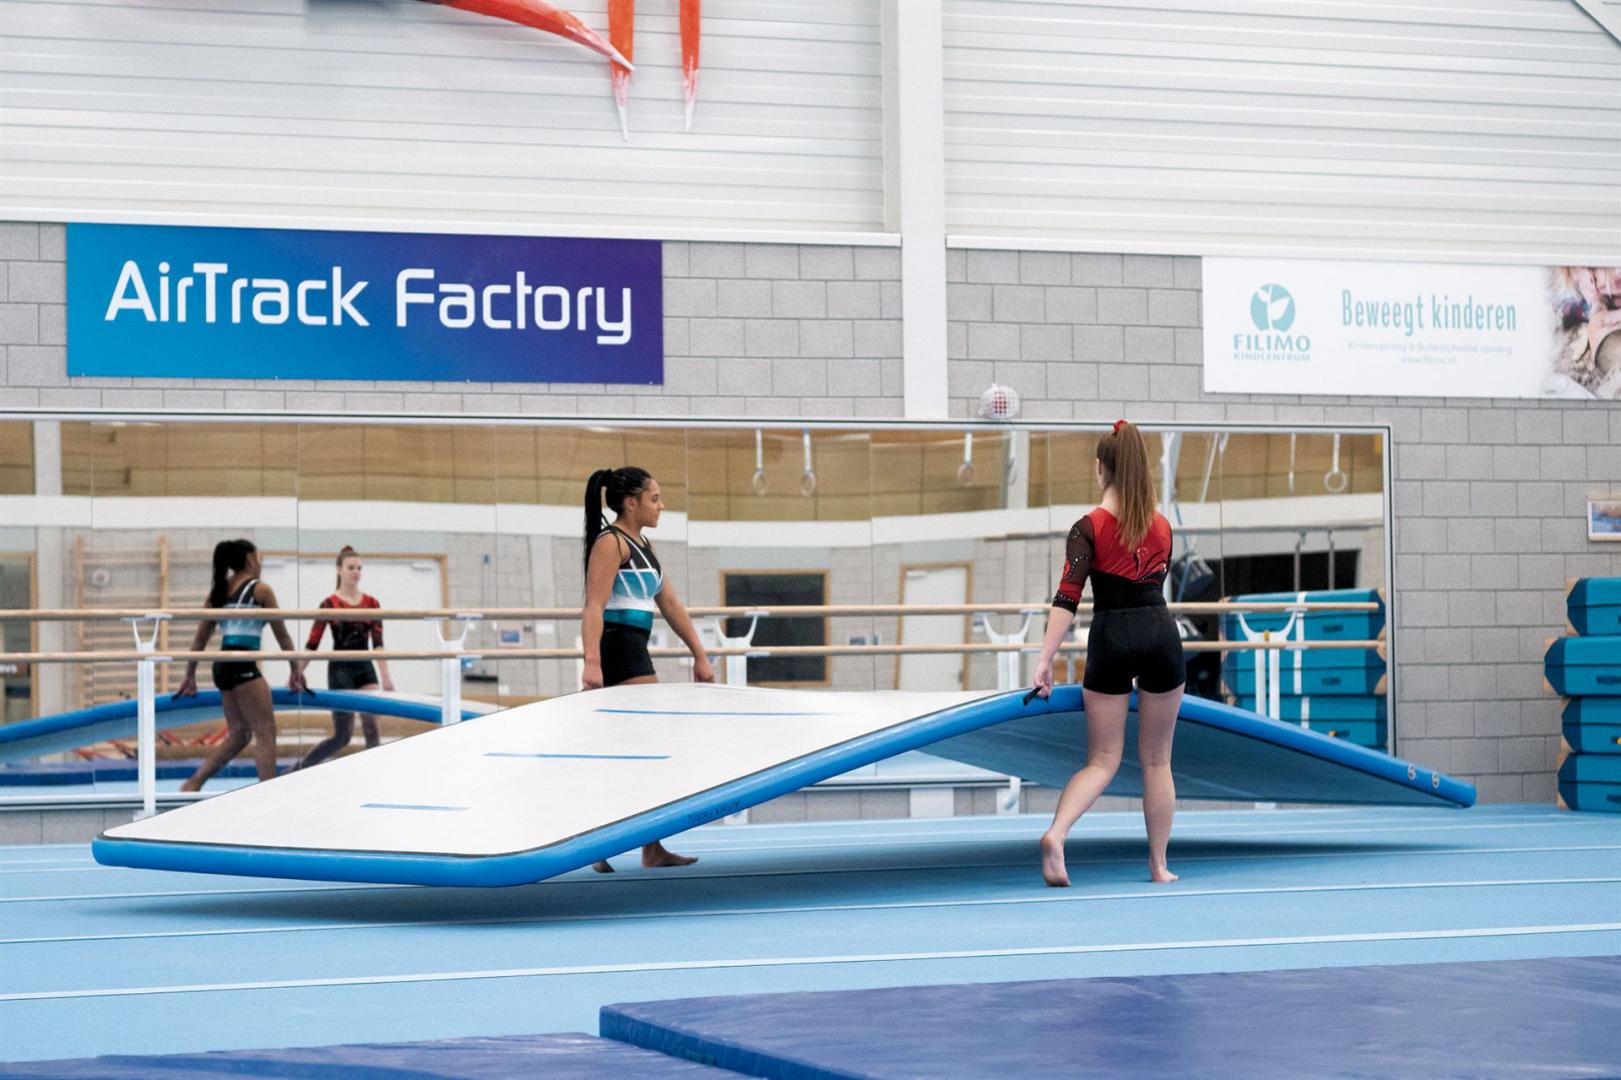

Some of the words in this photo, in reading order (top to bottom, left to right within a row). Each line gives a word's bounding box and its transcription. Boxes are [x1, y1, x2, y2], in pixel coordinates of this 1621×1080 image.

[104, 260, 370, 328] AirTrack
[395, 268, 632, 345] Factory
[1341, 288, 1424, 338] Beweegt
[1432, 294, 1517, 332] kinderen
[1233, 333, 1311, 352] FILIMO
[1233, 352, 1311, 362] KINDCENTRUM
